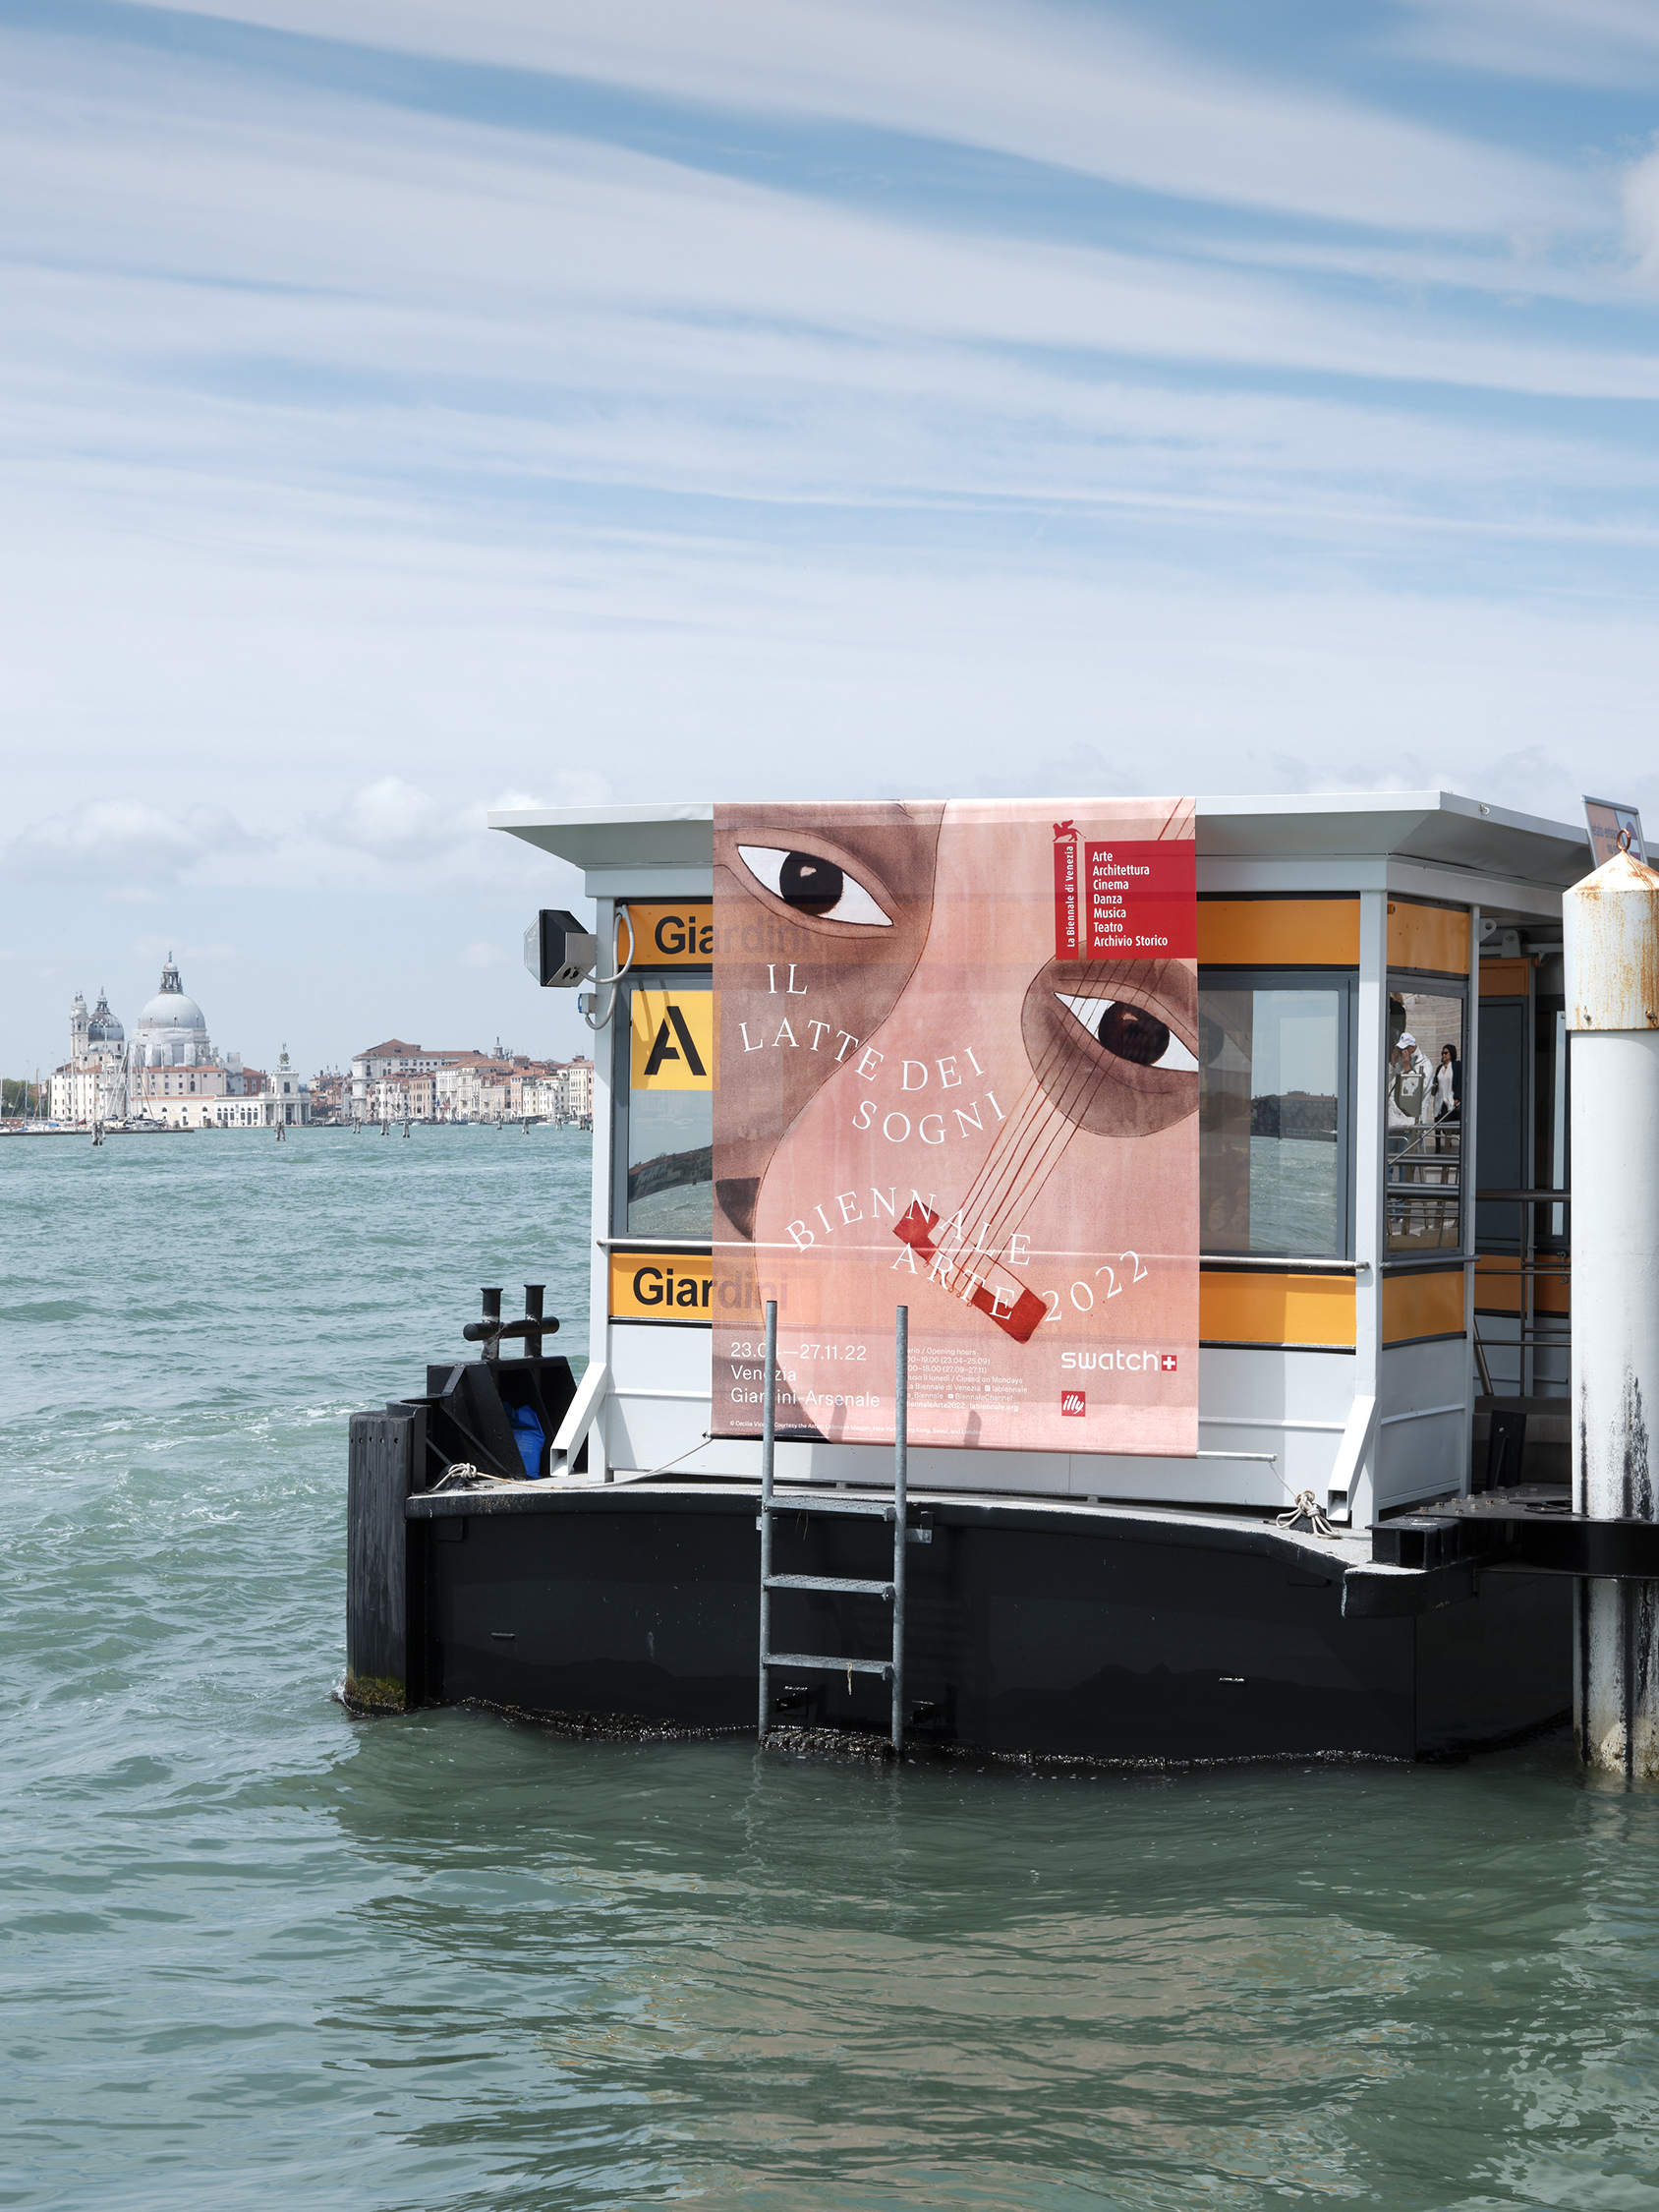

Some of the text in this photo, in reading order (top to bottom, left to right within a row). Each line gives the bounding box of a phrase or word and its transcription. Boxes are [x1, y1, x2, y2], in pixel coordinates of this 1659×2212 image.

[1092, 851, 1114, 862] Arte
[1092, 864, 1150, 876] Architettura
[1093, 879, 1129, 891] Cinema
[1064, 845, 1075, 948] La Biennale di Venezia
[1093, 894, 1122, 904] Danza
[1093, 907, 1127, 918] Musica
[1093, 922, 1123, 933] Teatro
[1093, 935, 1169, 947] Archivio Storico
[767, 963, 808, 995] IL
[644, 1006, 708, 1077] A
[738, 1017, 985, 1091] LATTE DEI
[851, 1090, 1006, 1144] SOGNI
[784, 1187, 1032, 1266] BIENNALE
[889, 1242, 1149, 1322] ARTE 2022
[1061, 1349, 1159, 1371] swatch
[992, 1376, 1022, 1385] Mondays
[730, 1387, 881, 1407] Giarini-Arsenale
[955, 1393, 1013, 1402] BiennaleChannel
[1062, 1394, 1084, 1415] illy
[969, 1402, 1019, 1413] labiennale.org
